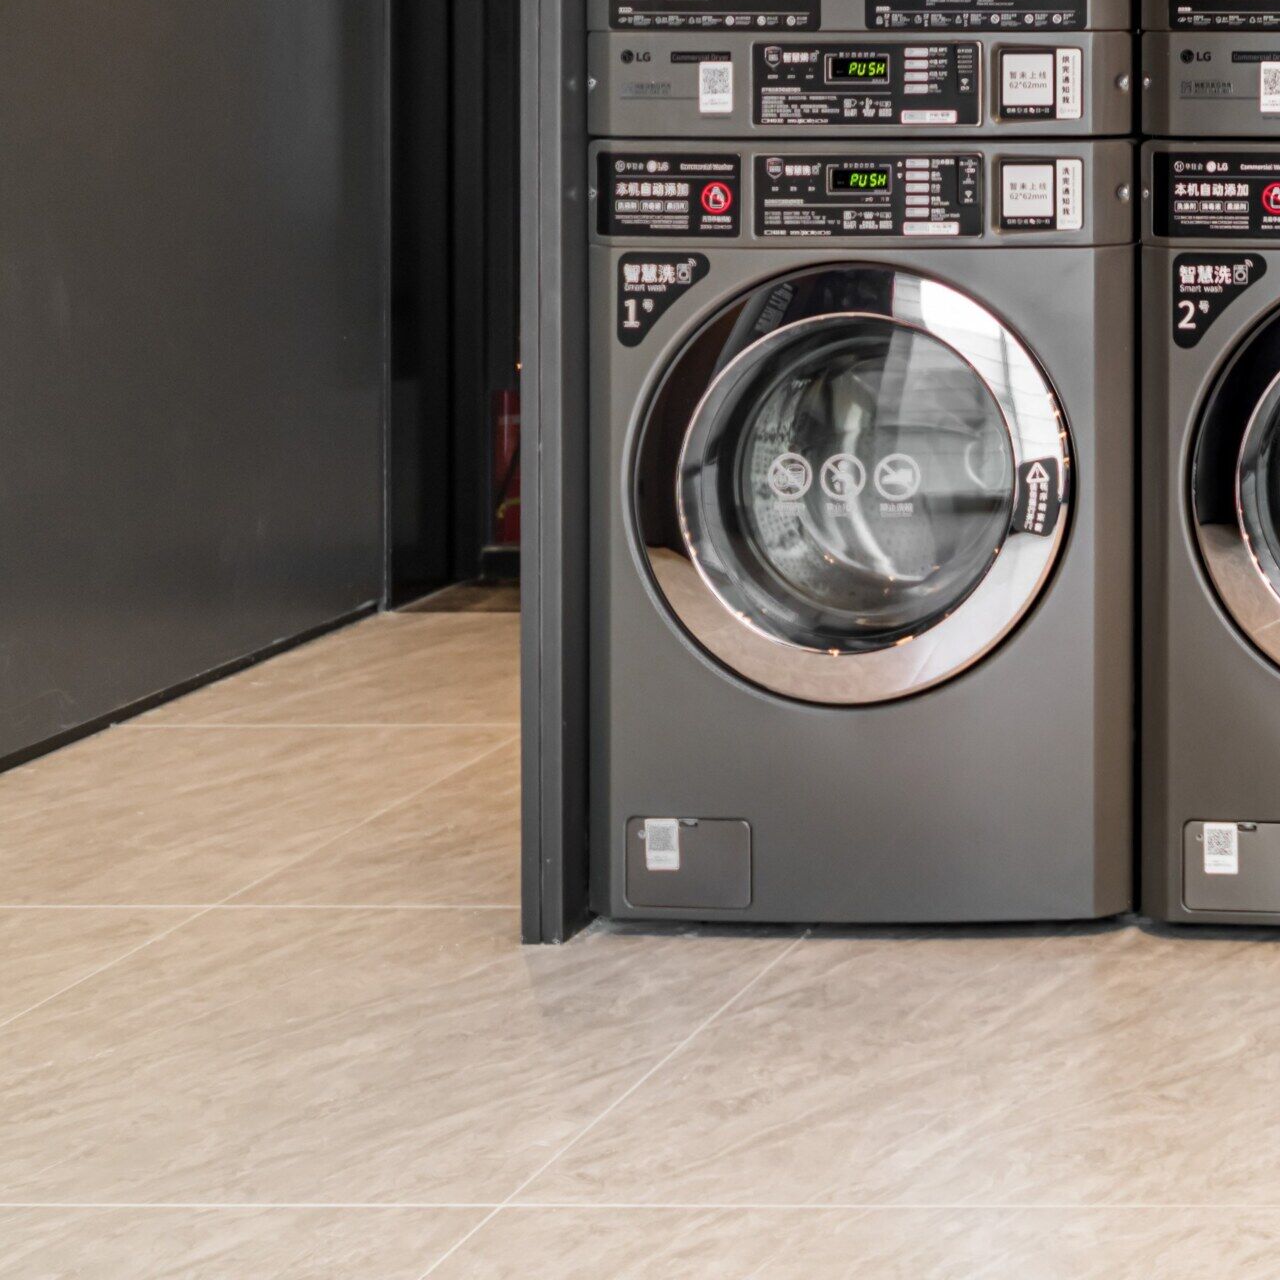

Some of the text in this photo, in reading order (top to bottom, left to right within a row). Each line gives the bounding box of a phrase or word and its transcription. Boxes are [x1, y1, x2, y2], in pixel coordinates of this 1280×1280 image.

[672, 52, 710, 61] Commercial
[1232, 52, 1271, 61] Commercial
[848, 61, 886, 76] PUSH
[1009, 71, 1047, 79] 暂未上线
[849, 173, 887, 187] PUSH
[1009, 182, 1047, 190] 暂未上线
[1175, 183, 1249, 197] 本机自动添加
[1180, 265, 1232, 284] 智慧洗
[1180, 285, 1223, 293] Smart wash
